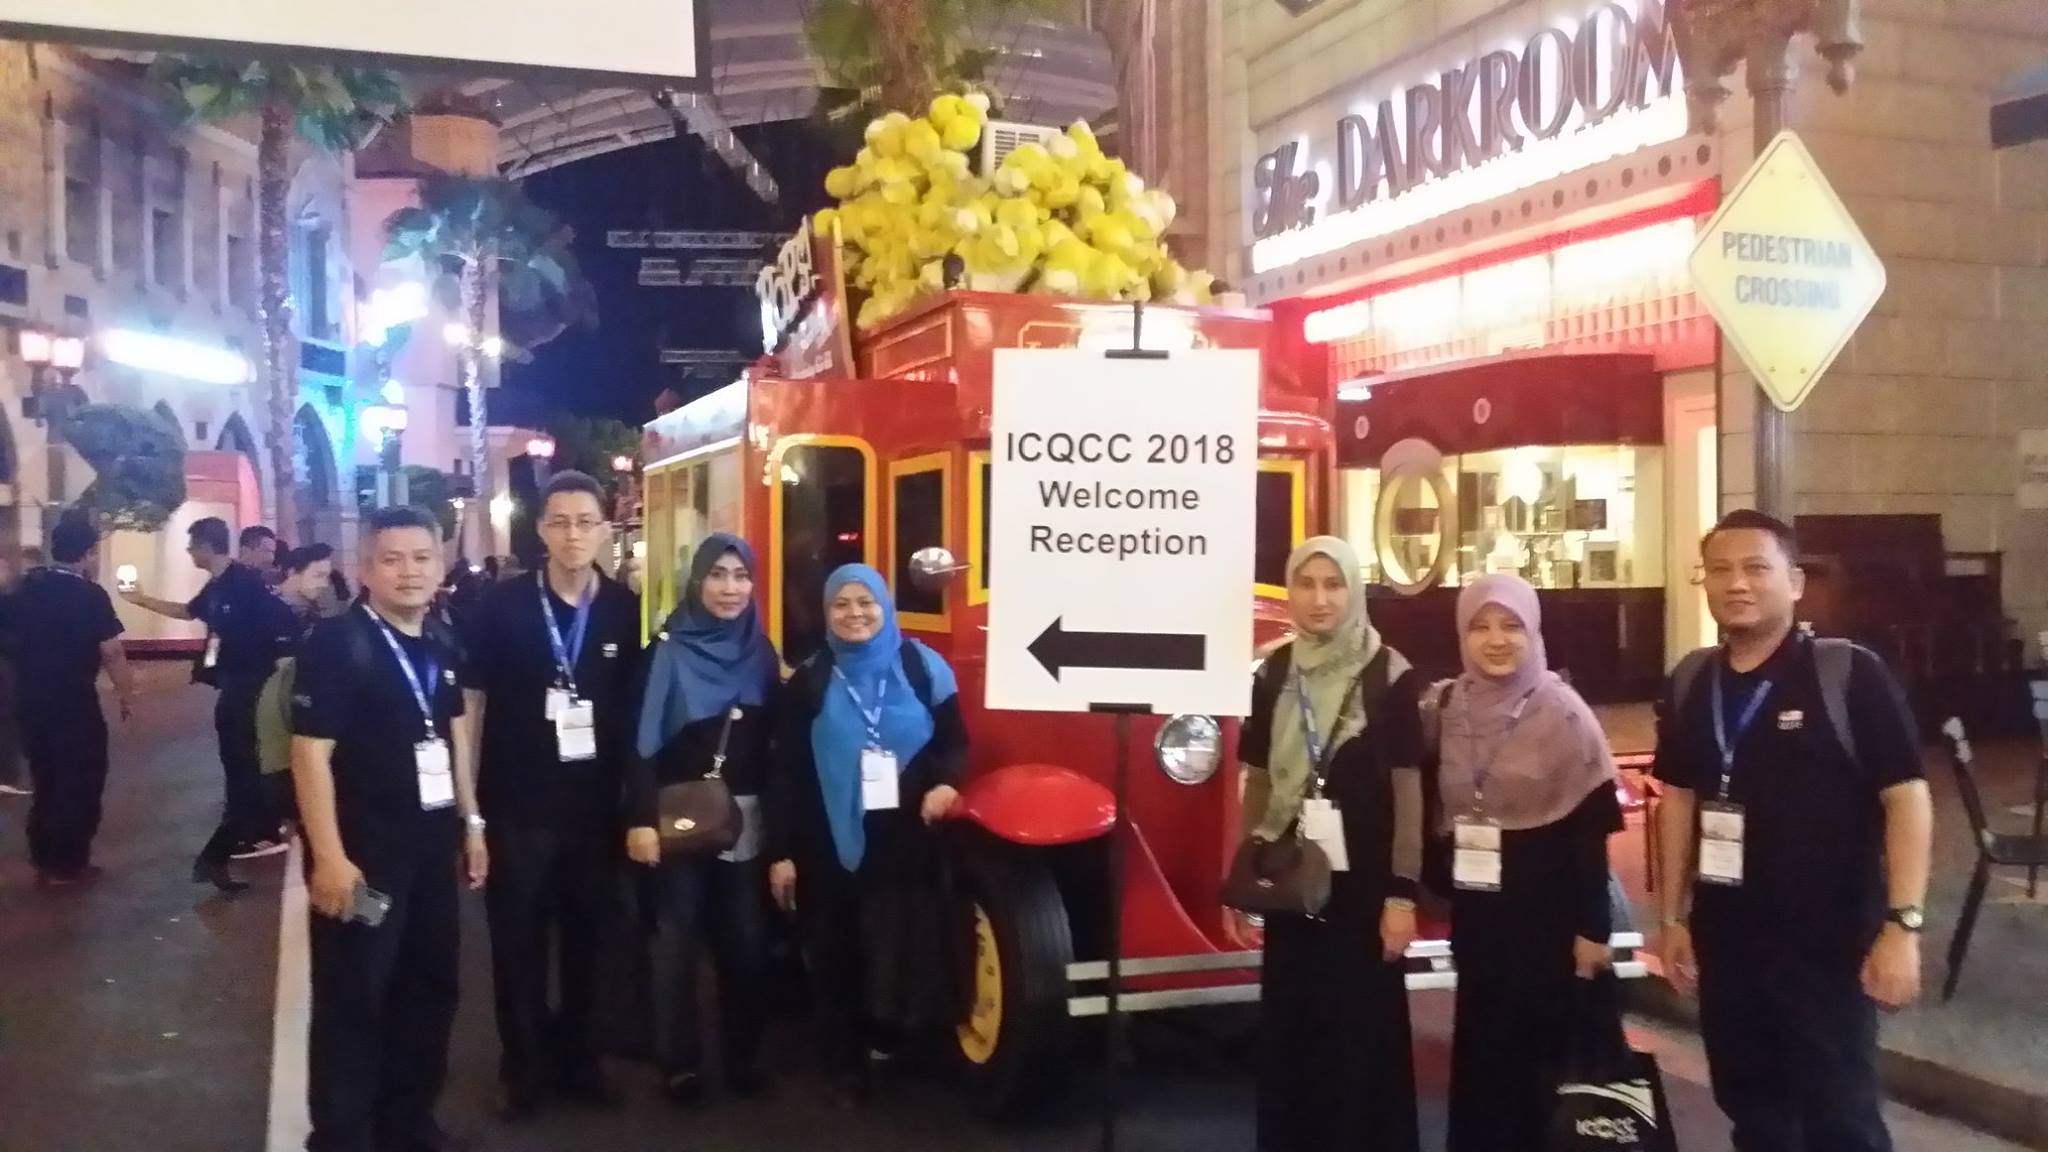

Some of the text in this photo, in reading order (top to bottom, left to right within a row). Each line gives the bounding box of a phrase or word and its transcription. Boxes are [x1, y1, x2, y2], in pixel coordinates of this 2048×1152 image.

[1252, 0, 1688, 238] The DARKROOM
[1721, 231, 1852, 269] PEDESTRIAN
[1735, 274, 1841, 311] CROSSING
[1006, 432, 1236, 465] ICQCC 2018
[1039, 480, 1201, 511] Welcome
[1029, 525, 1208, 562] Reception
